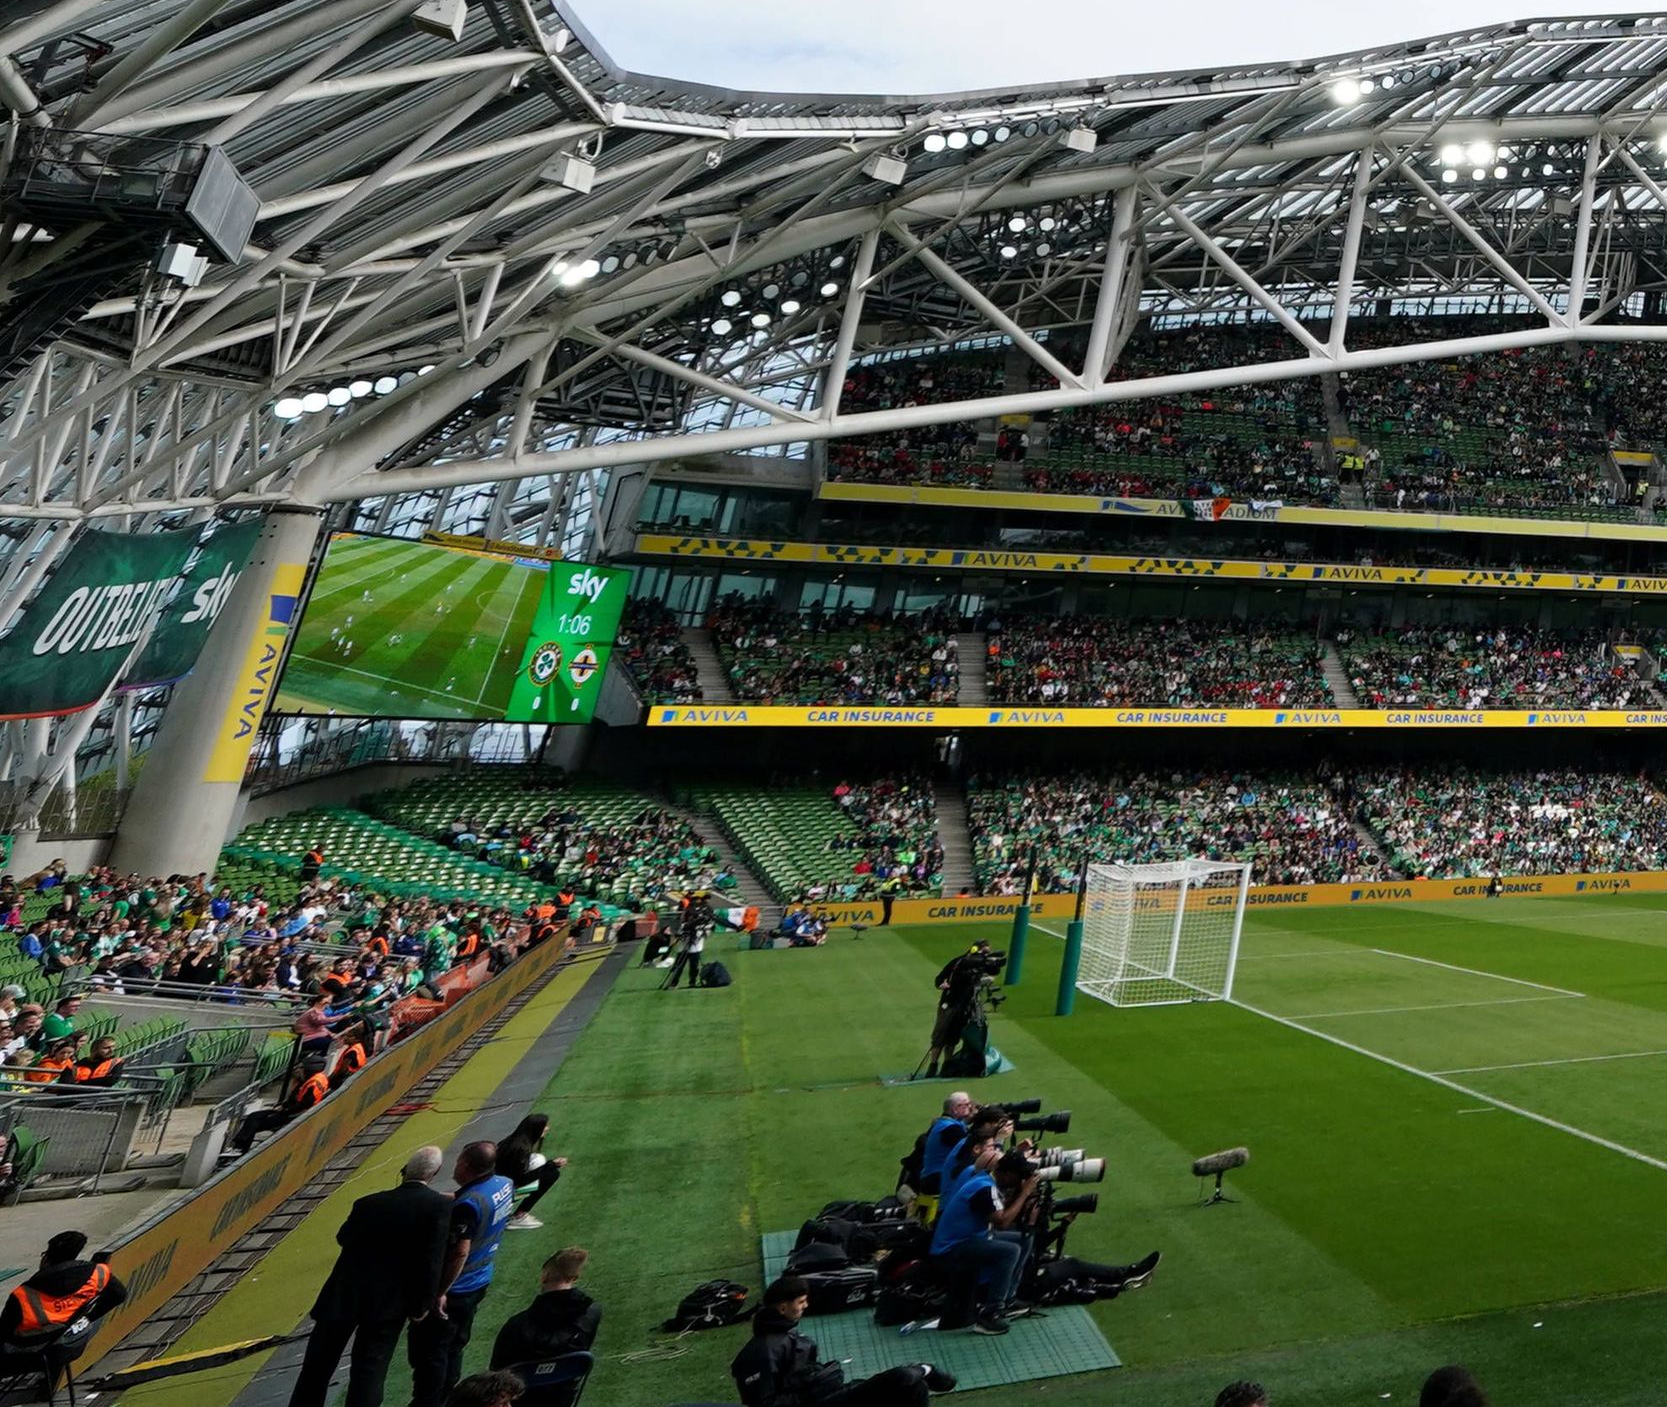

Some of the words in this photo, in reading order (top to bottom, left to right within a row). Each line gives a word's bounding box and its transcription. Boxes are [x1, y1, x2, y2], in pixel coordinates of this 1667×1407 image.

[972, 554, 1037, 568] AVIVA
[1329, 567, 1383, 580] AVIVA
[567, 568, 610, 603] sky
[181, 561, 242, 631] sky
[558, 613, 592, 635] 1:06
[233, 643, 277, 740] AVIVA
[683, 710, 748, 722] AVIVA
[807, 711, 839, 722] CAR
[842, 711, 934, 723] INSURANCE
[1008, 712, 1065, 723] AVIVA
[1116, 712, 1145, 723] CAR
[1149, 712, 1227, 723] INSURANCE
[1293, 713, 1341, 724] AVIVA
[1386, 713, 1412, 724] CAR
[1414, 713, 1483, 724] INSURANCE
[1542, 714, 1586, 724] AVIVA
[1626, 714, 1649, 724] CAR
[1589, 879, 1631, 890] AVIVA
[1366, 888, 1412, 899] AVIVA
[1453, 885, 1476, 896] CAR
[1207, 895, 1233, 906] CAR
[928, 906, 957, 918] CAR
